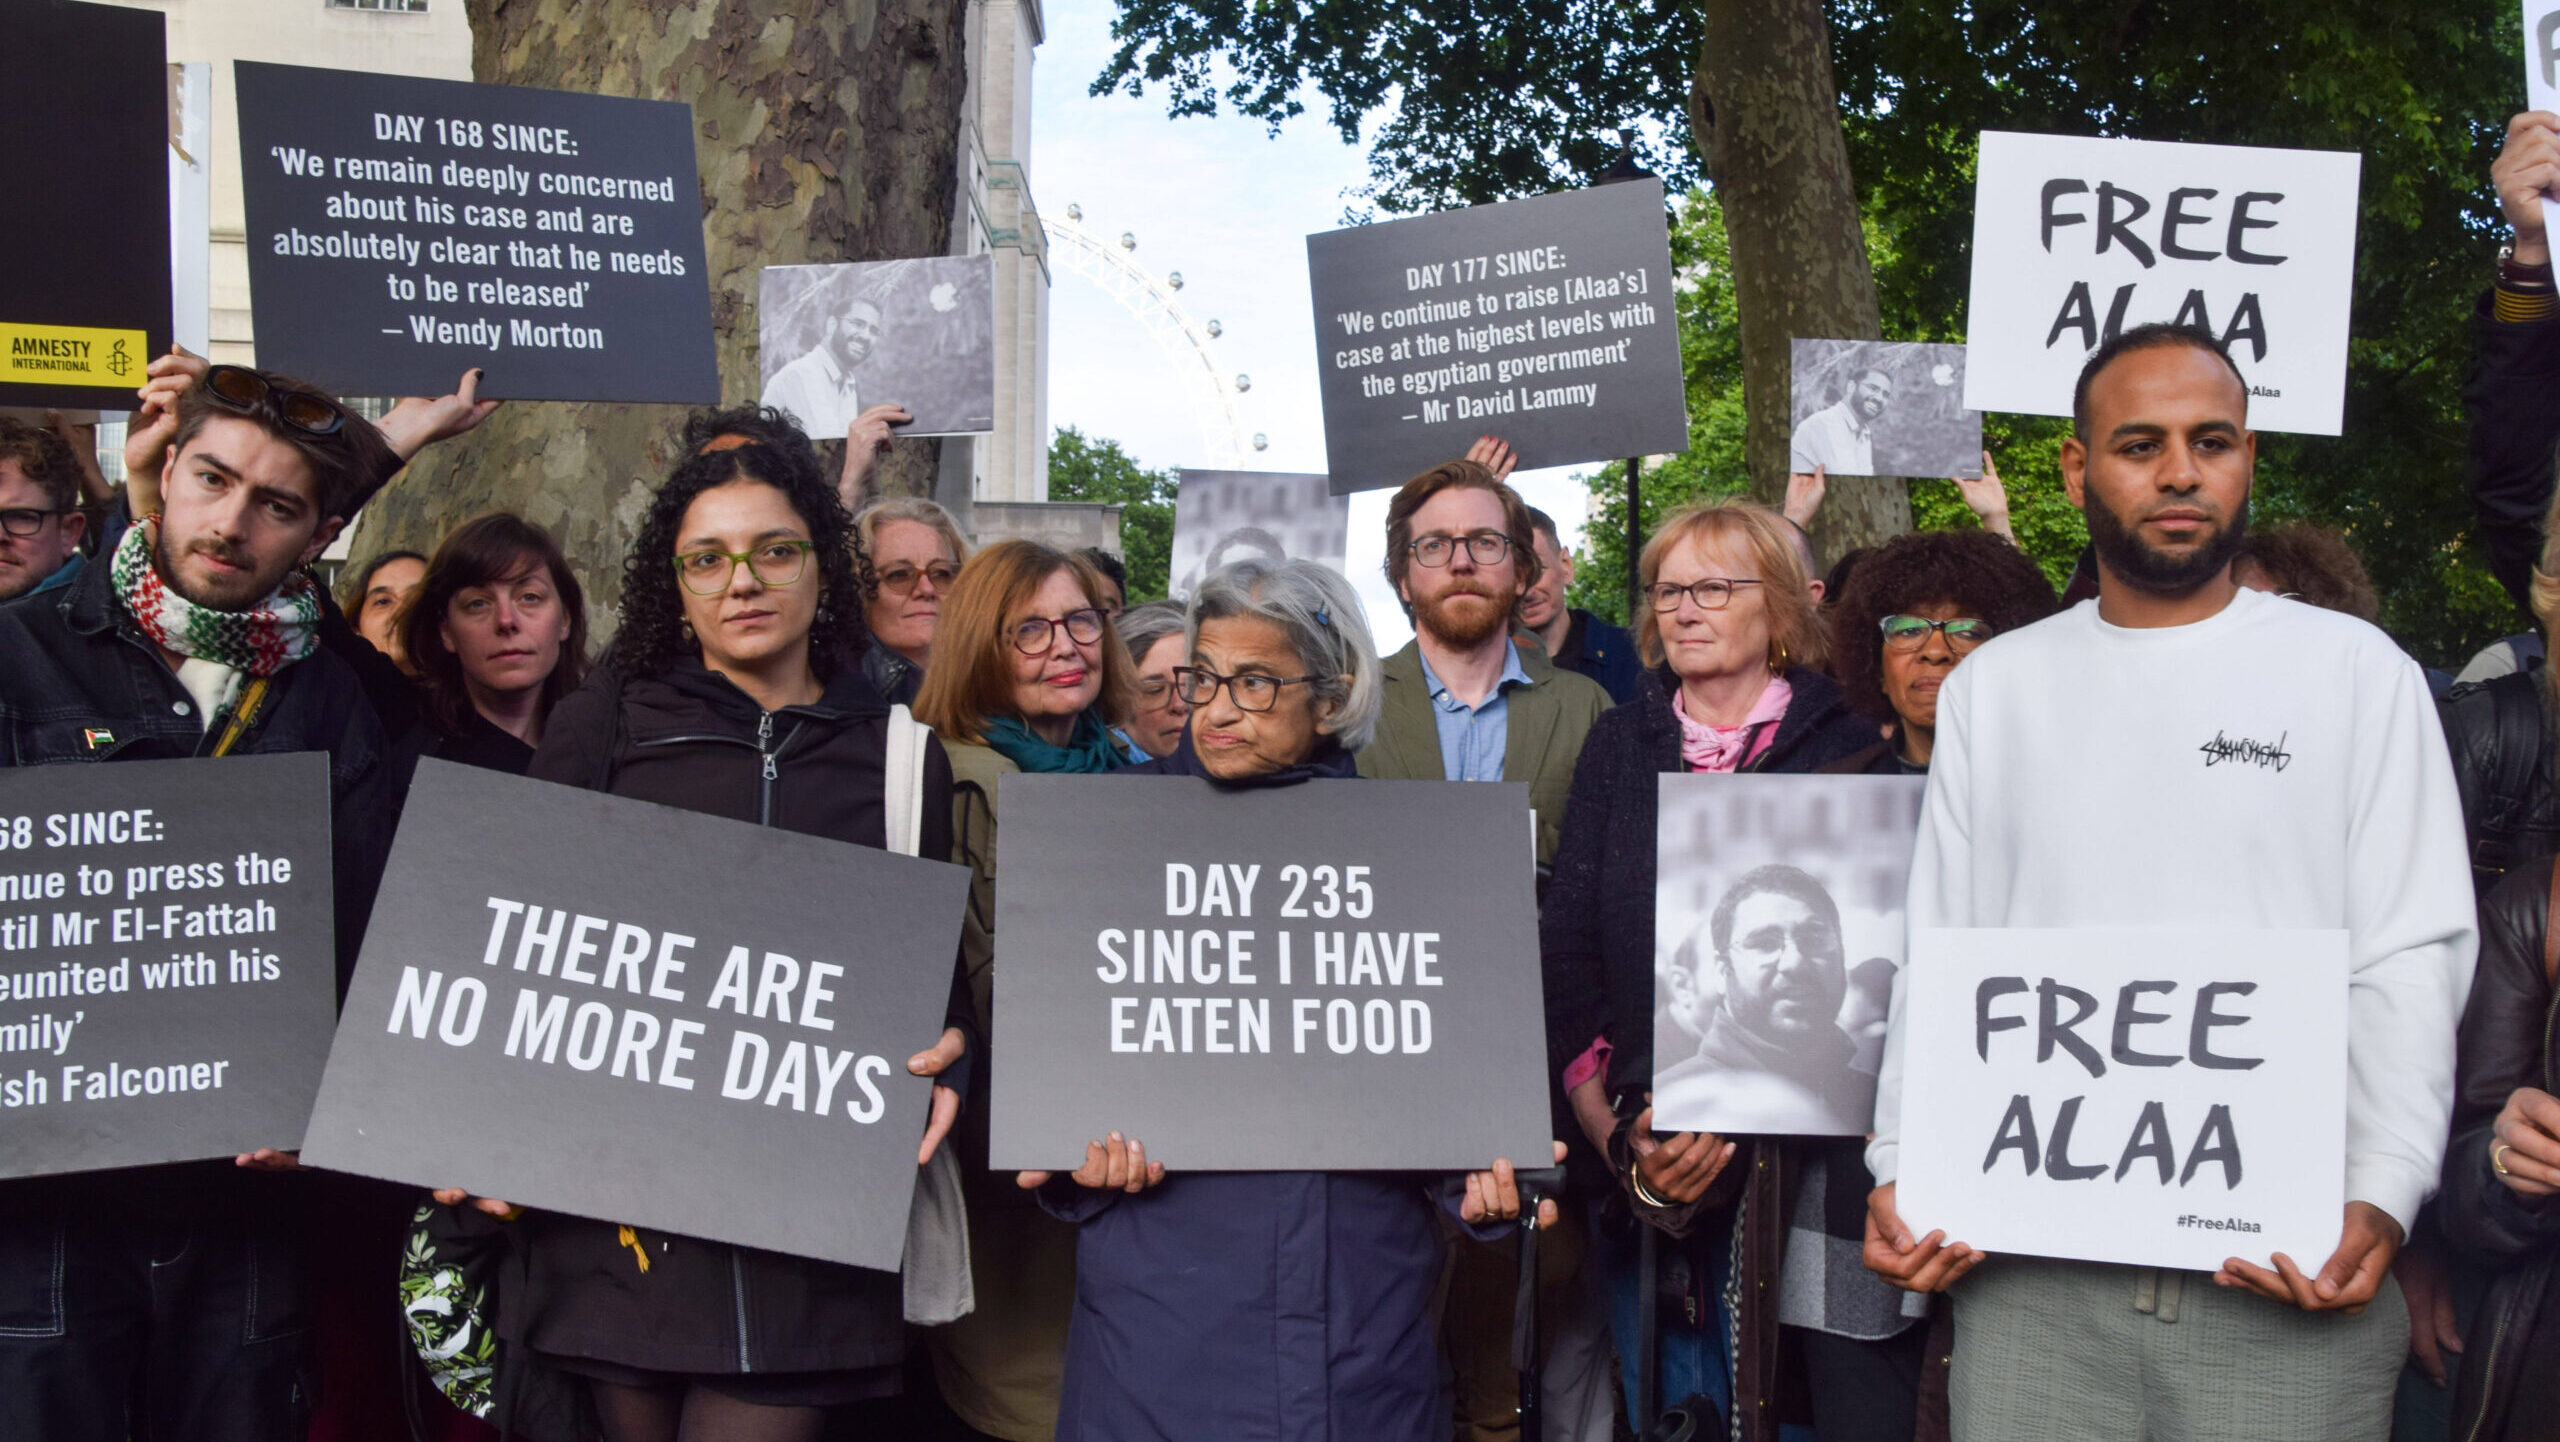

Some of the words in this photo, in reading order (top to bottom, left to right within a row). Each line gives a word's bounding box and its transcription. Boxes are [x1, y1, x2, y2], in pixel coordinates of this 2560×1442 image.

[375, 113, 424, 142] DAY
[436, 119, 483, 147] 168
[492, 124, 578, 155] SINCE:
[335, 157, 432, 184] remain
[443, 160, 529, 196] deeply
[539, 173, 674, 202] concerned
[327, 191, 407, 221] about
[415, 196, 455, 224] his
[465, 205, 527, 228] case
[536, 207, 583, 232] and
[592, 214, 633, 235] are
[2041, 179, 2288, 269] FREE
[274, 228, 420, 266] absolutely
[430, 236, 500, 265] clear
[508, 241, 562, 269] that
[570, 244, 600, 270] he
[611, 250, 685, 275] needs
[1407, 264, 1443, 290] DAY
[1452, 257, 1487, 283] 177
[1496, 246, 1566, 276] SINCE:
[387, 274, 415, 300] to
[425, 274, 458, 302] be
[1381, 300, 1471, 329] continue
[1477, 294, 1498, 314] to
[1505, 285, 1558, 310] raise
[12, 338, 90, 357] AMNESTY
[410, 315, 501, 351] Wendy
[511, 319, 603, 348] Morton
[1336, 346, 1383, 368] case
[1391, 338, 1411, 360] at
[1416, 333, 1450, 356] the
[1456, 320, 1535, 352] highest
[1541, 310, 1603, 339] levels
[1609, 302, 1655, 328] with
[13, 358, 91, 372] INTERNATIONAL
[1362, 374, 1395, 397] the
[1403, 361, 1491, 394] egyptian
[1423, 400, 1450, 423] Mr
[1457, 390, 1514, 419] David
[1521, 384, 1596, 410] Lammy
[46, 810, 163, 847] SINCE:
[78, 865, 113, 896] to
[128, 863, 224, 900] press
[235, 853, 291, 885] the
[1167, 864, 1260, 916] DAY
[1280, 865, 1373, 918] 235
[53, 912, 99, 946] Mr
[113, 899, 275, 942] El-Fattah
[142, 952, 216, 989] with
[230, 948, 280, 982] his
[484, 897, 696, 1002] THERE
[707, 946, 844, 1031] ARE
[1097, 929, 1256, 984] SINCE
[1279, 931, 1291, 984] I
[1315, 932, 1443, 985] HAVE
[387, 966, 487, 1046] NO
[504, 989, 705, 1090] MORE
[721, 1031, 890, 1124] DAYS
[1111, 998, 1270, 1053] EATEN
[1293, 999, 1431, 1054] FOOD
[1976, 977, 2264, 1078] FREE
[63, 1061, 228, 1101] Falconer
[1983, 1095, 2242, 1190] ALAA
[2177, 1215, 2261, 1233] #FreeAlaa
